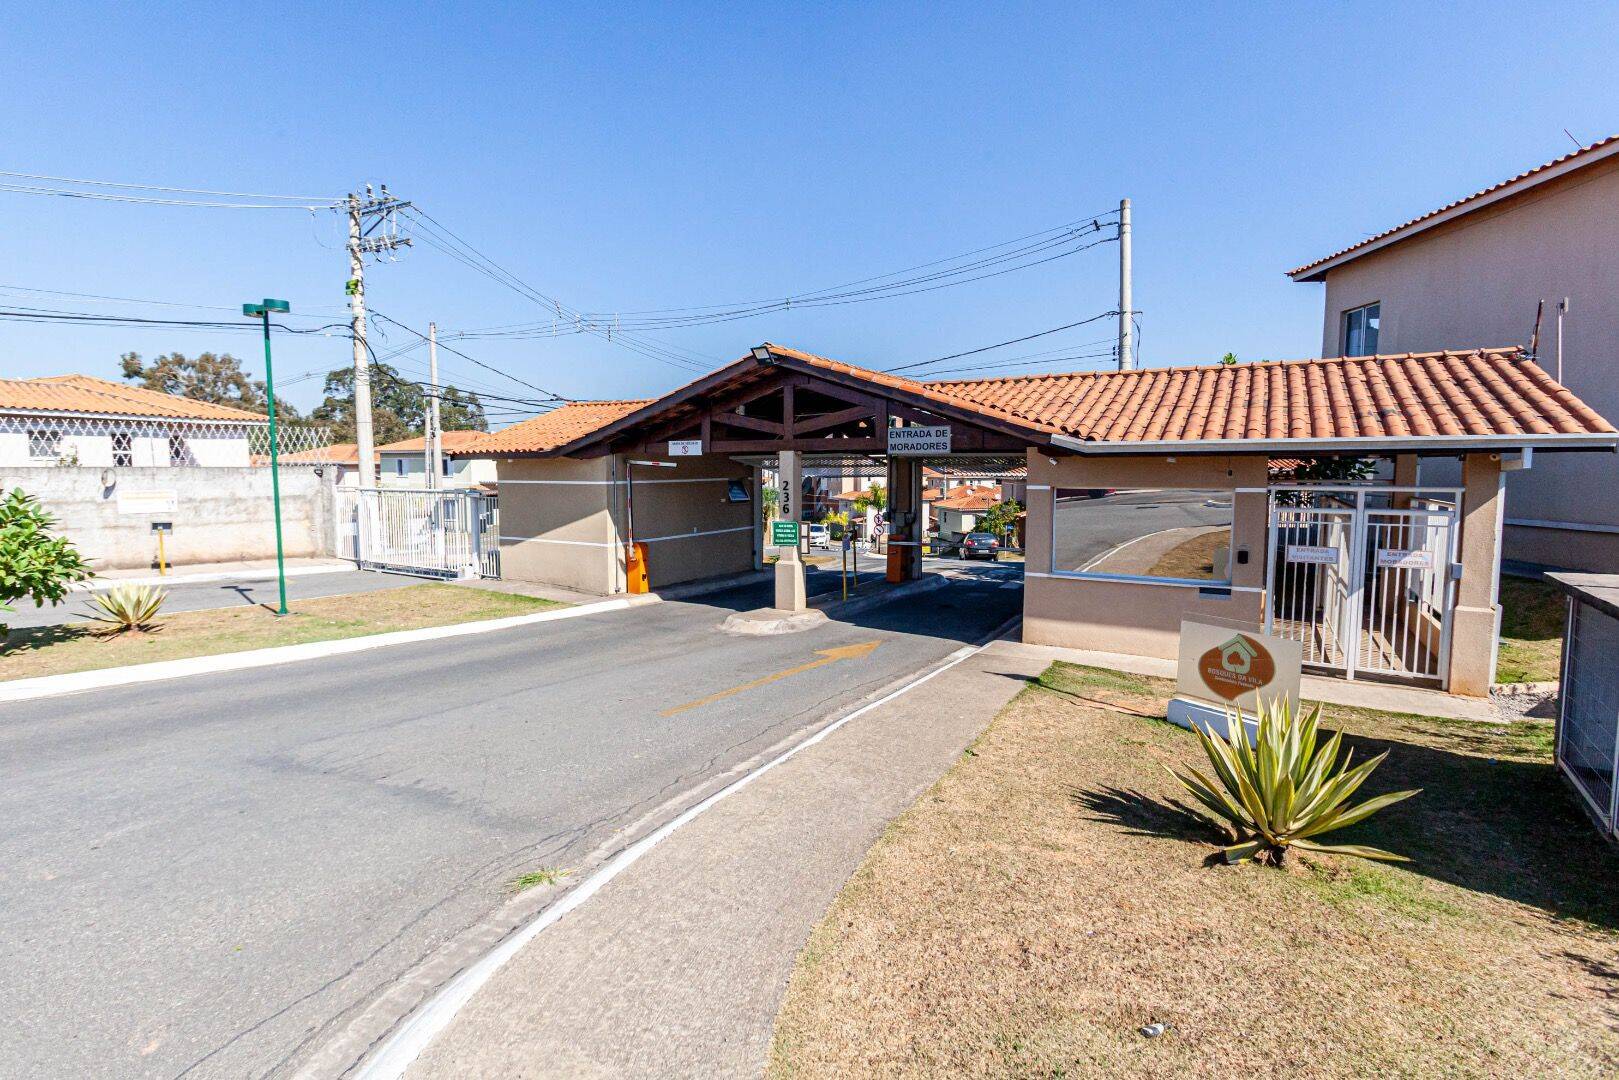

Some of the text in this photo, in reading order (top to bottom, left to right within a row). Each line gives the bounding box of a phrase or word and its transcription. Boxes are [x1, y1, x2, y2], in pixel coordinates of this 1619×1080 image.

[889, 429, 948, 439] ENTRADA DE
[889, 442, 948, 451] MORADORES
[782, 480, 790, 514] 236
[1207, 667, 1238, 679] BOSQUES
[1248, 676, 1263, 686] VILA
